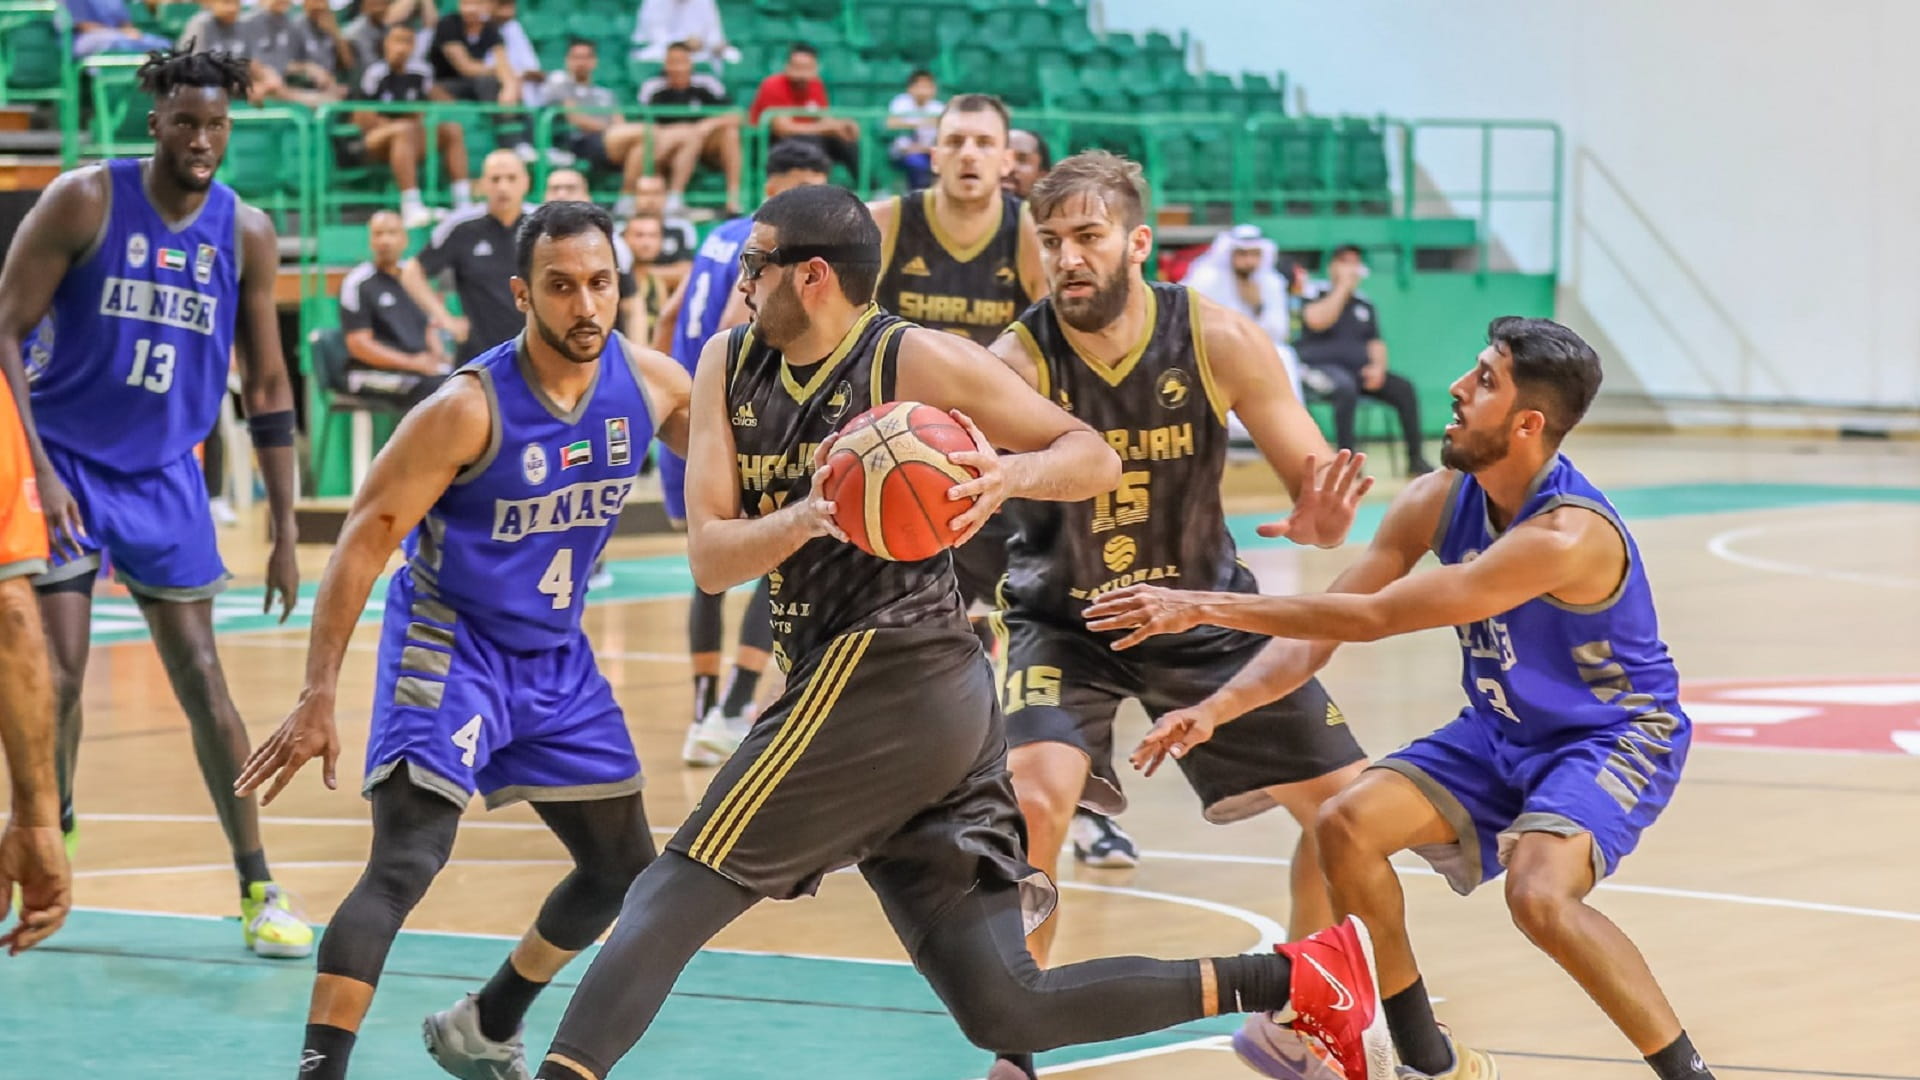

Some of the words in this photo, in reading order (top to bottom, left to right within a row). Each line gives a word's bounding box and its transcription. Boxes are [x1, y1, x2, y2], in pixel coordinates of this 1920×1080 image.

[106, 284, 138, 312] AL
[149, 290, 210, 329] NASR
[687, 271, 710, 338] 1
[898, 291, 1015, 326] SHARJAH
[126, 338, 175, 394] 13
[1100, 422, 1195, 461] RJAH
[499, 504, 540, 536] AL
[1091, 471, 1151, 533] 15
[537, 549, 573, 610] 4
[1004, 665, 1063, 716] 15
[1476, 677, 1521, 723] 3
[451, 714, 483, 768] 4
